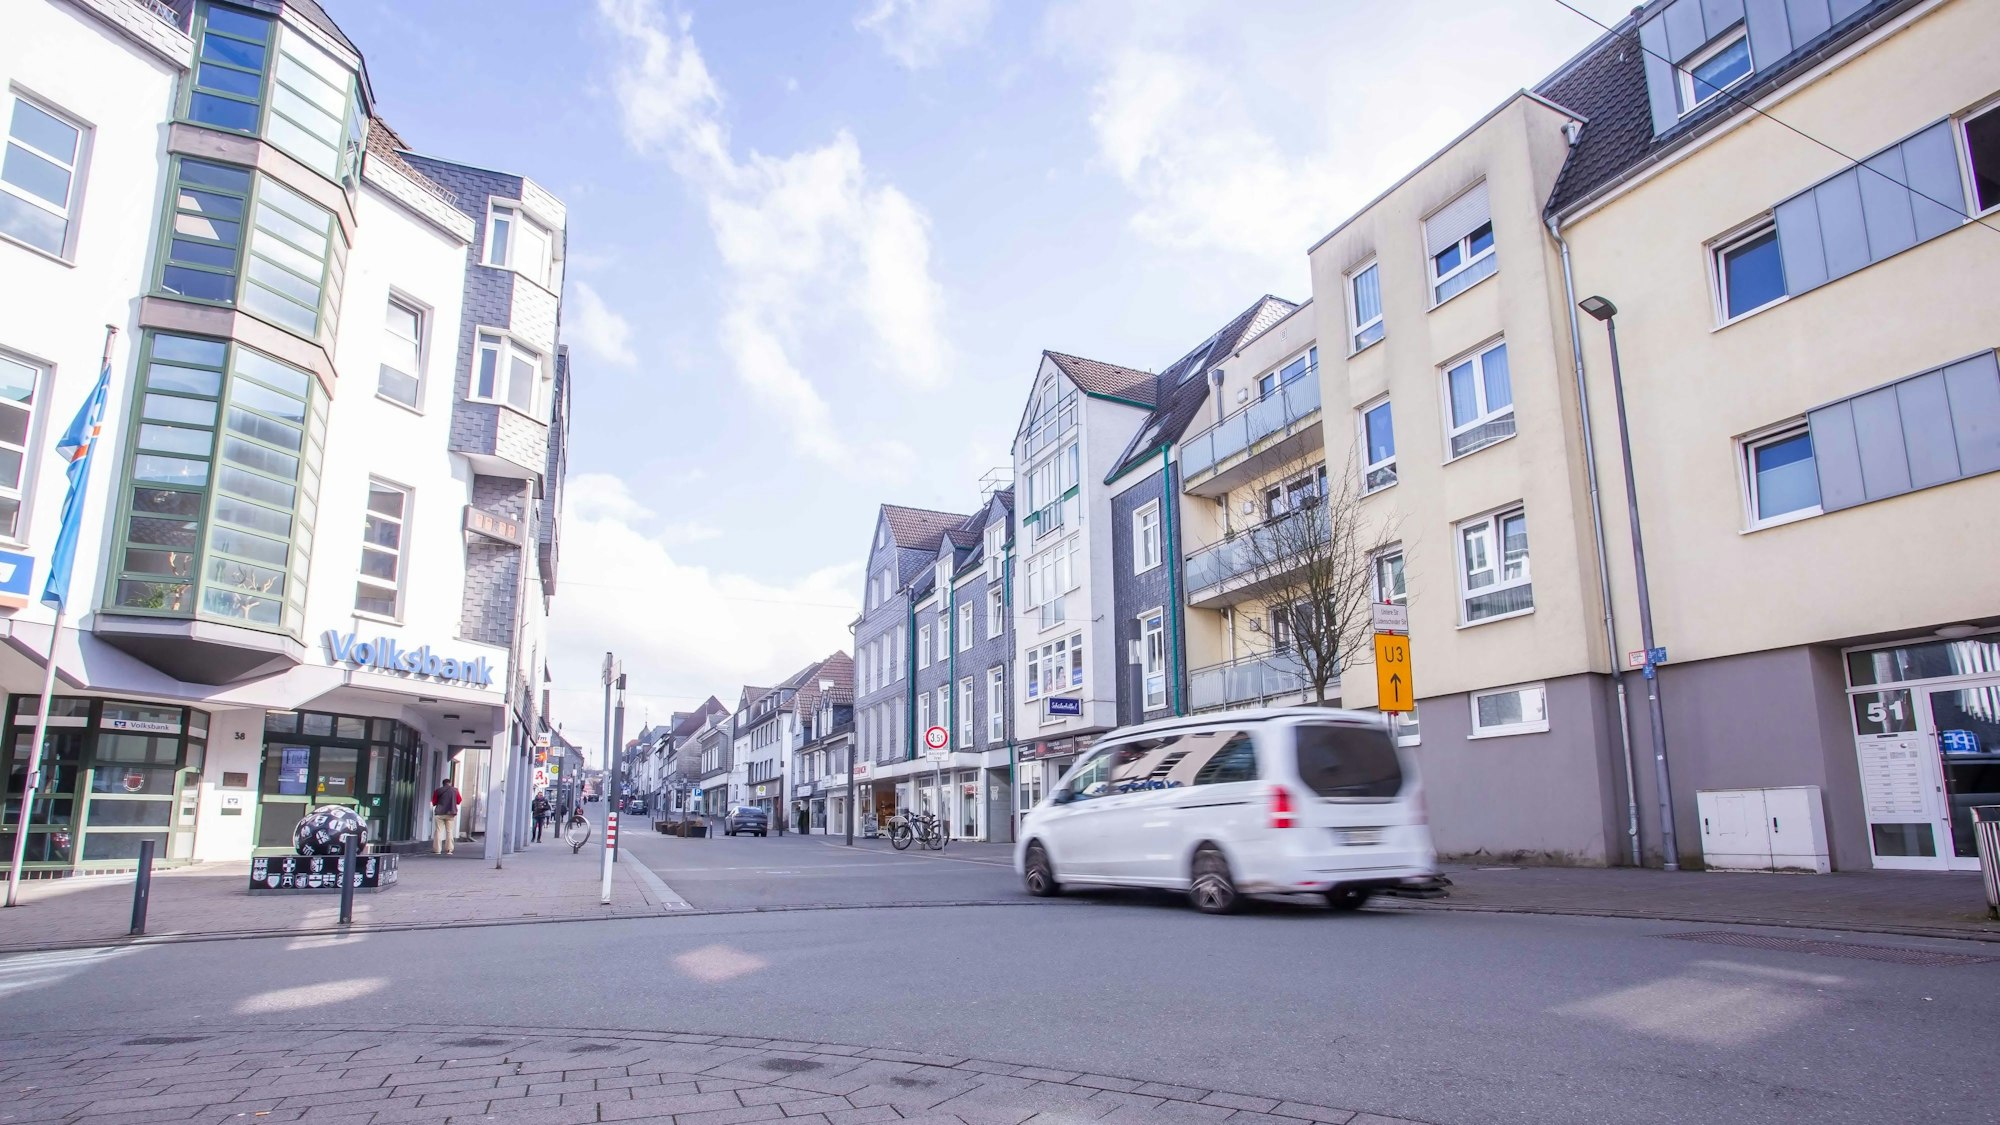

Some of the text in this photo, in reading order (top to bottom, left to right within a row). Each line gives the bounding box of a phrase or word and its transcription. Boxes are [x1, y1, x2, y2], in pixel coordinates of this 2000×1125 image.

[327, 629, 494, 685] Volksbank
[1384, 645, 1404, 663] U3
[1867, 700, 1904, 722] 51
[130, 721, 169, 731] Volksbank
[234, 731, 246, 741] 38
